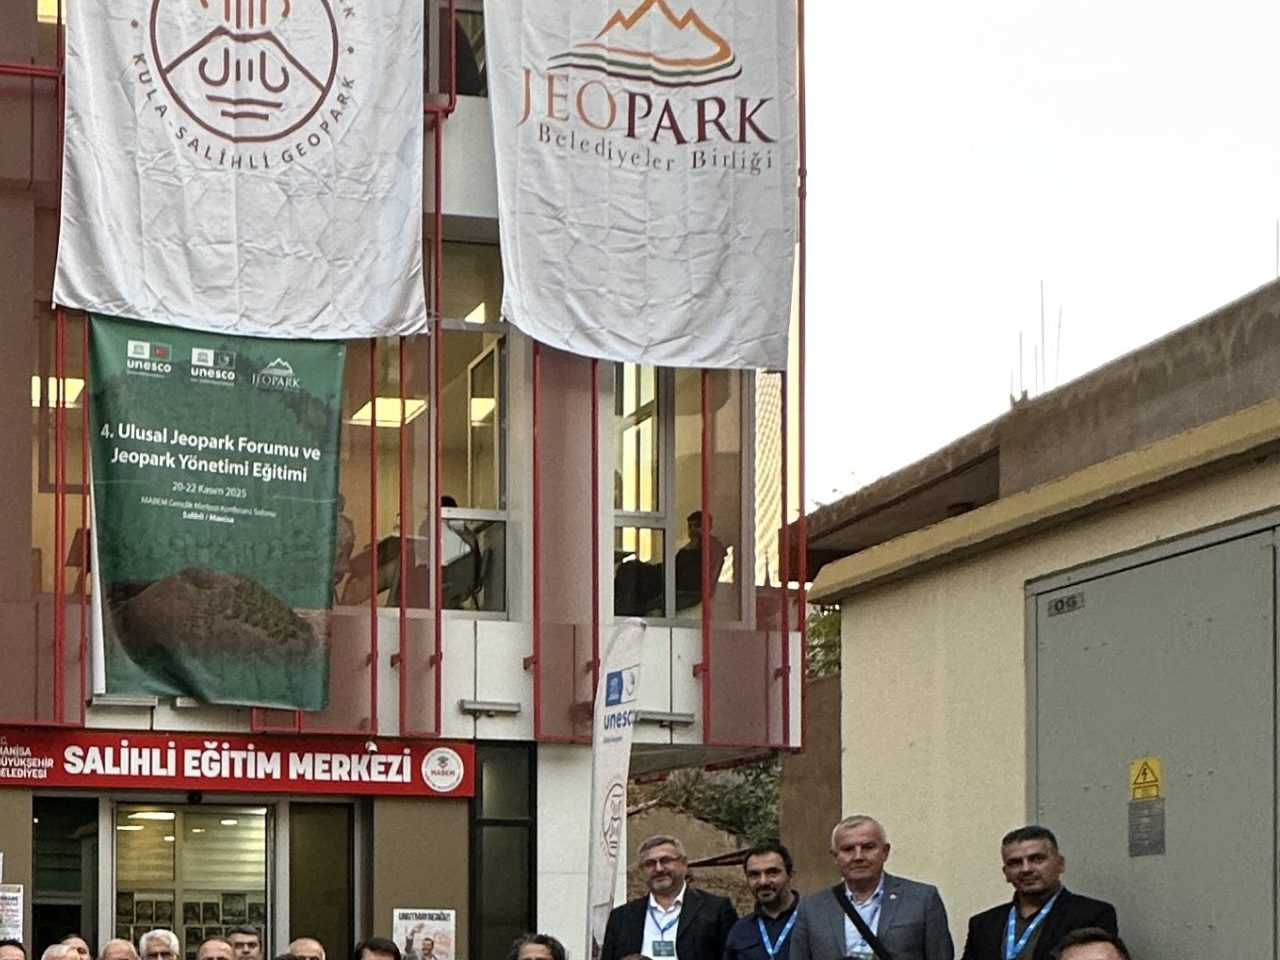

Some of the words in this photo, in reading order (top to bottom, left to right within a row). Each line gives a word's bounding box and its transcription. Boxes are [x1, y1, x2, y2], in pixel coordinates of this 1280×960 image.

[281, 77, 356, 164] GEOPARK
[517, 67, 780, 146] JEOPARK
[538, 123, 676, 172] Belediyeler
[692, 149, 773, 175] Birliği
[127, 359, 172, 373] unesco
[191, 367, 236, 381] unesco
[100, 423, 114, 439] 4.
[118, 423, 168, 444] Ulusal
[170, 430, 234, 451] Jeopark
[238, 437, 299, 458] Forumu
[302, 447, 321, 460] ve
[111, 448, 176, 468] Jeopark
[178, 453, 249, 476] Yönetimi
[253, 462, 308, 483] Eğitimi
[171, 481, 197, 493] 20-22
[225, 487, 247, 499] 2025
[604, 709, 634, 730] unesc
[63, 739, 176, 777] SALİHLİ
[183, 741, 281, 780] EĞİTİM
[289, 747, 412, 783] MERKEZİ
